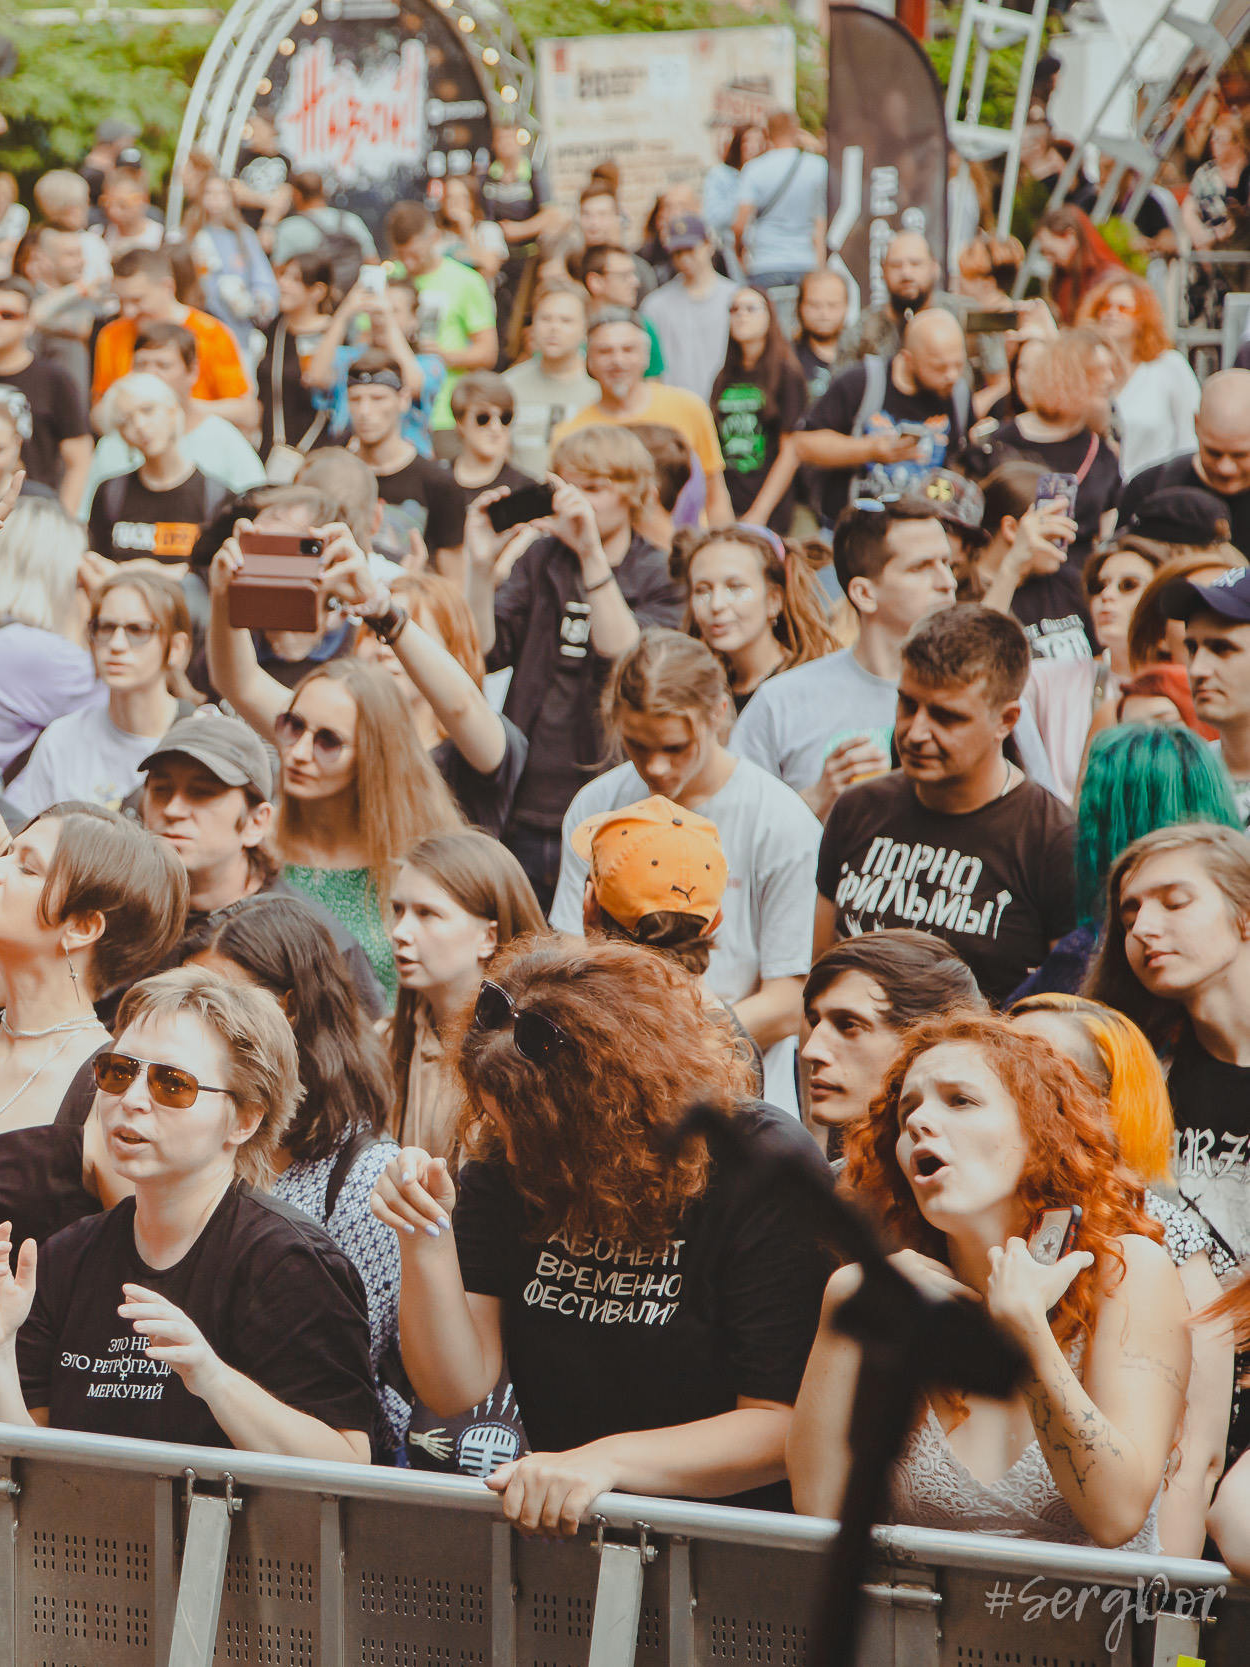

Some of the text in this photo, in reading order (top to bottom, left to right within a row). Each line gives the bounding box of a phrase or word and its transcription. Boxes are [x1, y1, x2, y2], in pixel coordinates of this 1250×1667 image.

[861, 837, 983, 895] ПОРНО
[536, 1251, 683, 1298] ВРЕМЕННО
[108, 1337, 129, 1352] ЭТО
[60, 1351, 90, 1370] ЭТО
[86, 1383, 164, 1400] МЕРКУРИЙ
